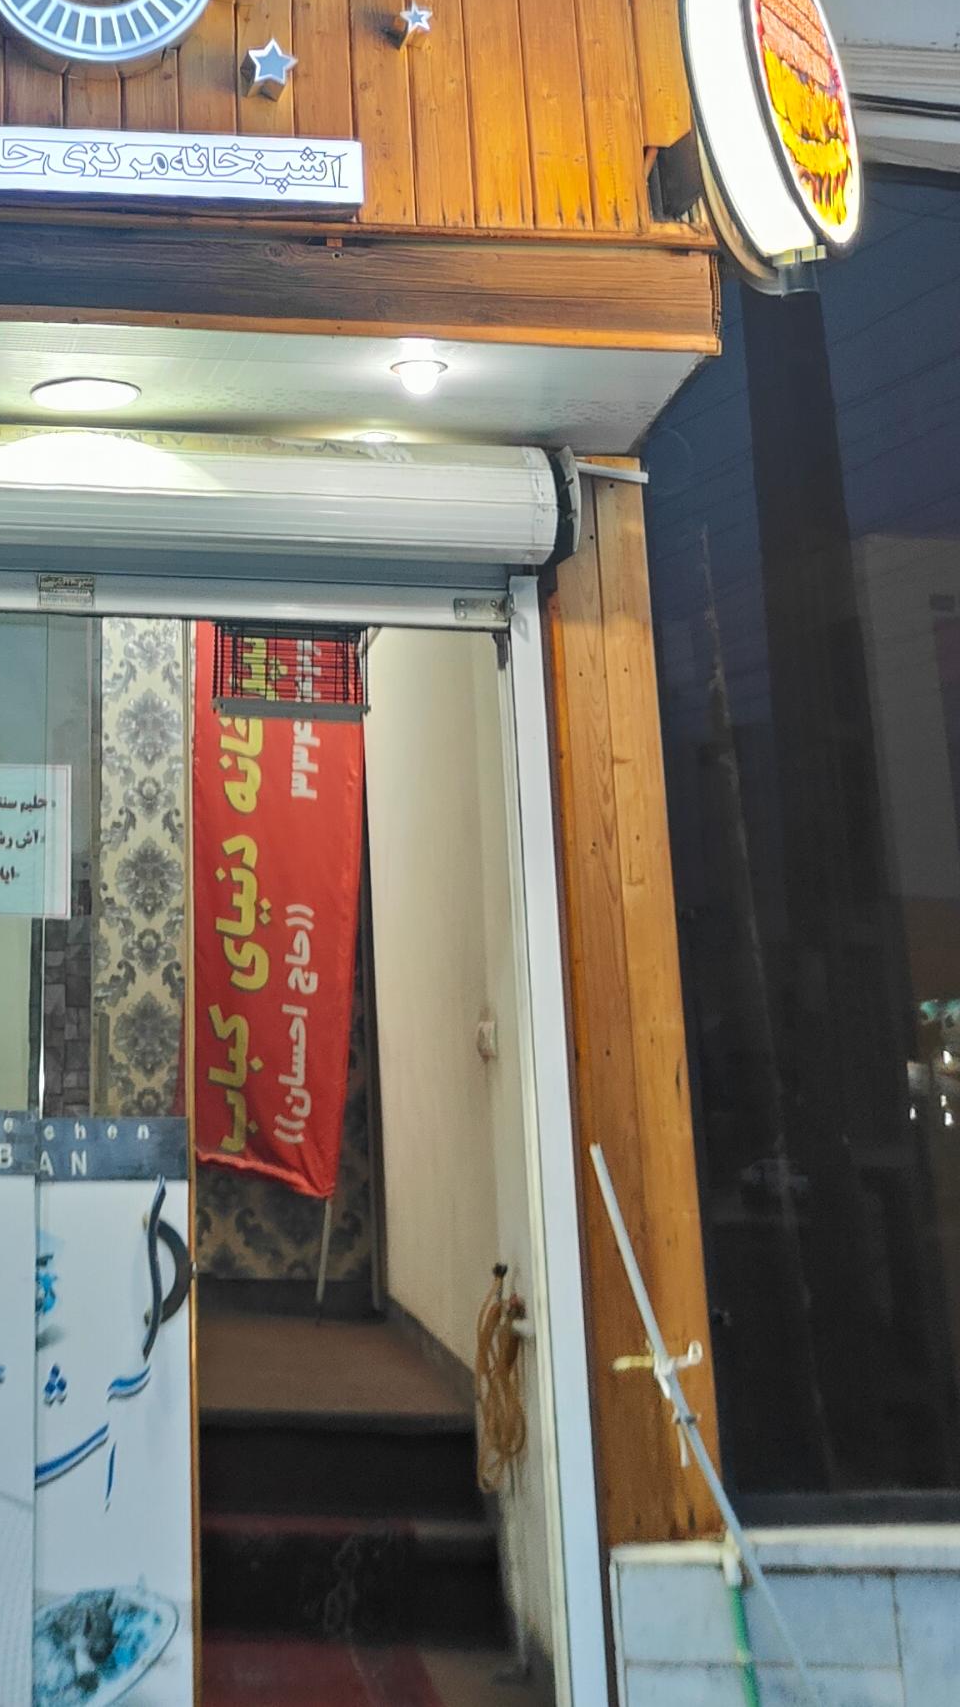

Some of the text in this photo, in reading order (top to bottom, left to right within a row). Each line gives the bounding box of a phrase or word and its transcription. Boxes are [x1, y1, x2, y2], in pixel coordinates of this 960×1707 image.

[43, 139, 169, 180] مرکزی
[171, 143, 349, 193] آشپزخانه
[20, 794, 47, 813] حلیم
[15, 829, 39, 848] آش
[216, 834, 271, 991] دنیای
[208, 1003, 264, 1154] کباب
